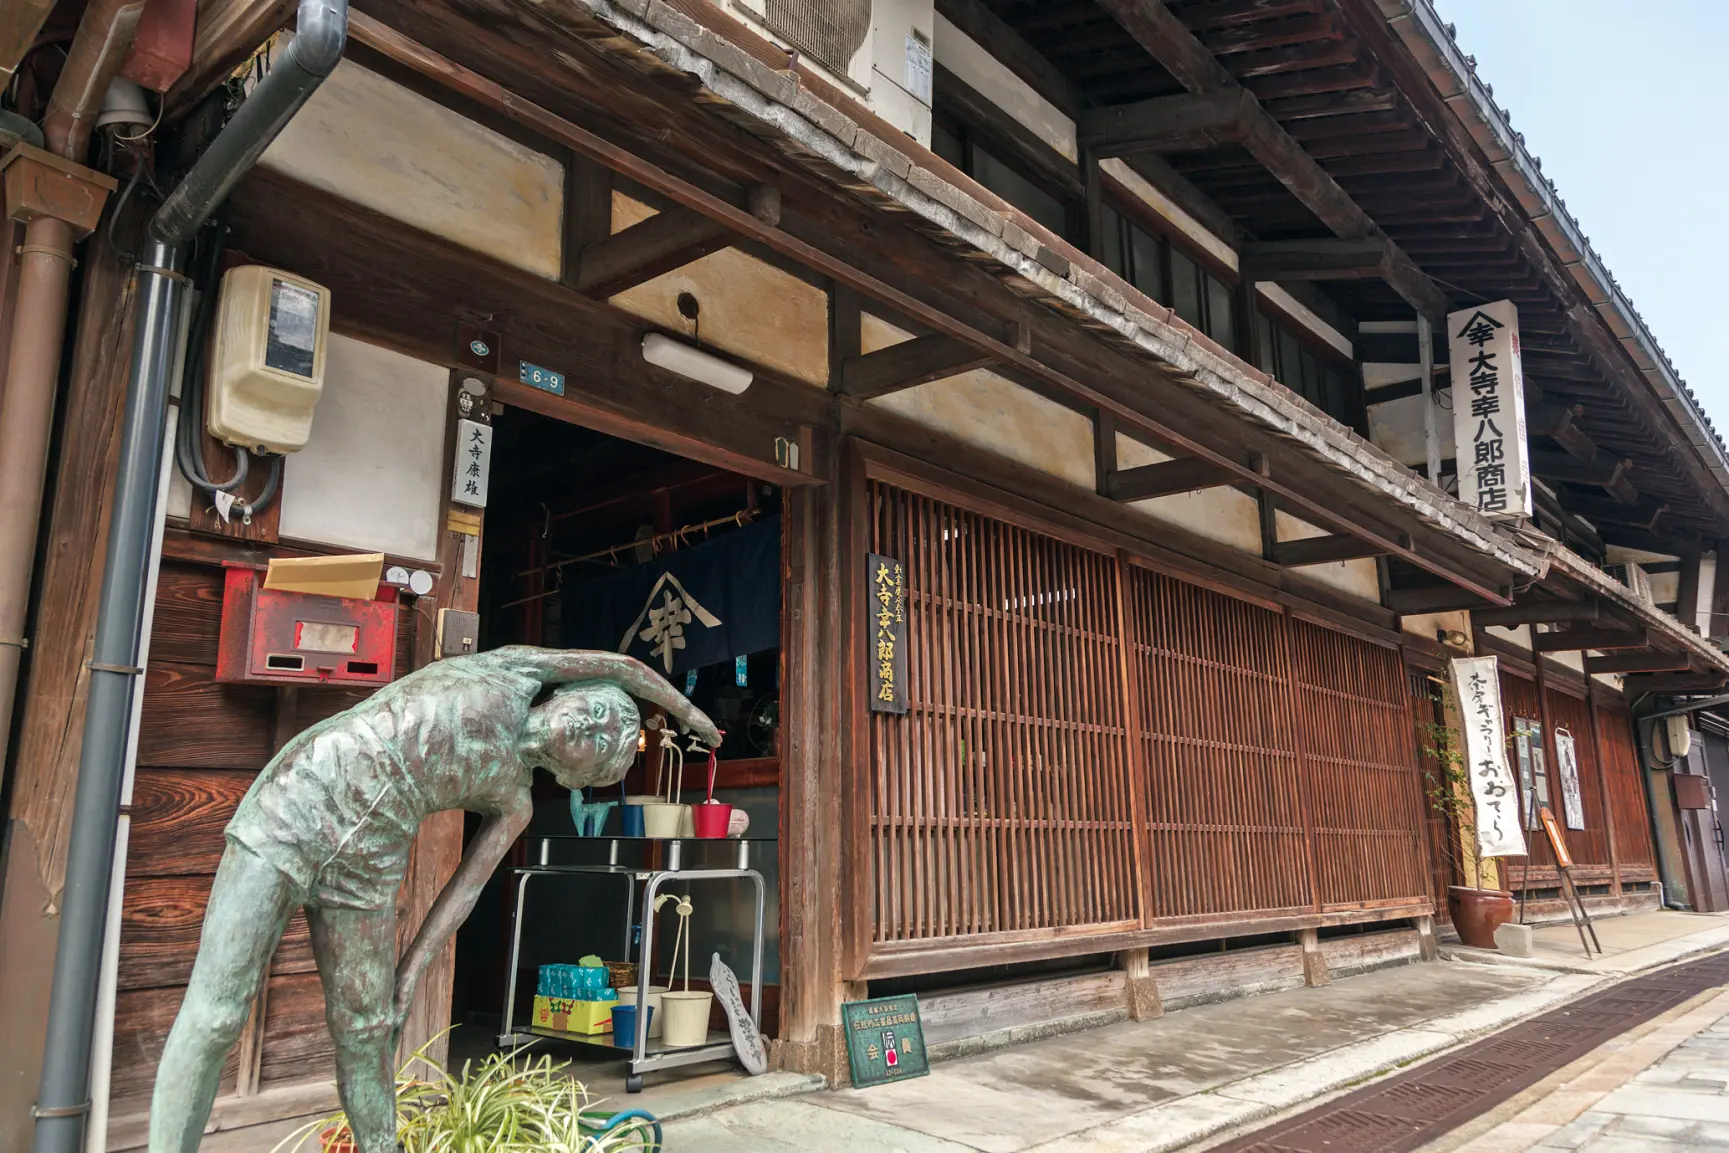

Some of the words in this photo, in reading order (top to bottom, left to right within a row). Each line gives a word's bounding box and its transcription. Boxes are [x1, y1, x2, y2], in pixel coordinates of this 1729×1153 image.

[533, 370, 558, 388] 6-9
[1468, 350, 1508, 512] 大寺幸八郎商店
[464, 428, 485, 496] 大寺康雄
[875, 562, 896, 702] 大寺幸八郎商店
